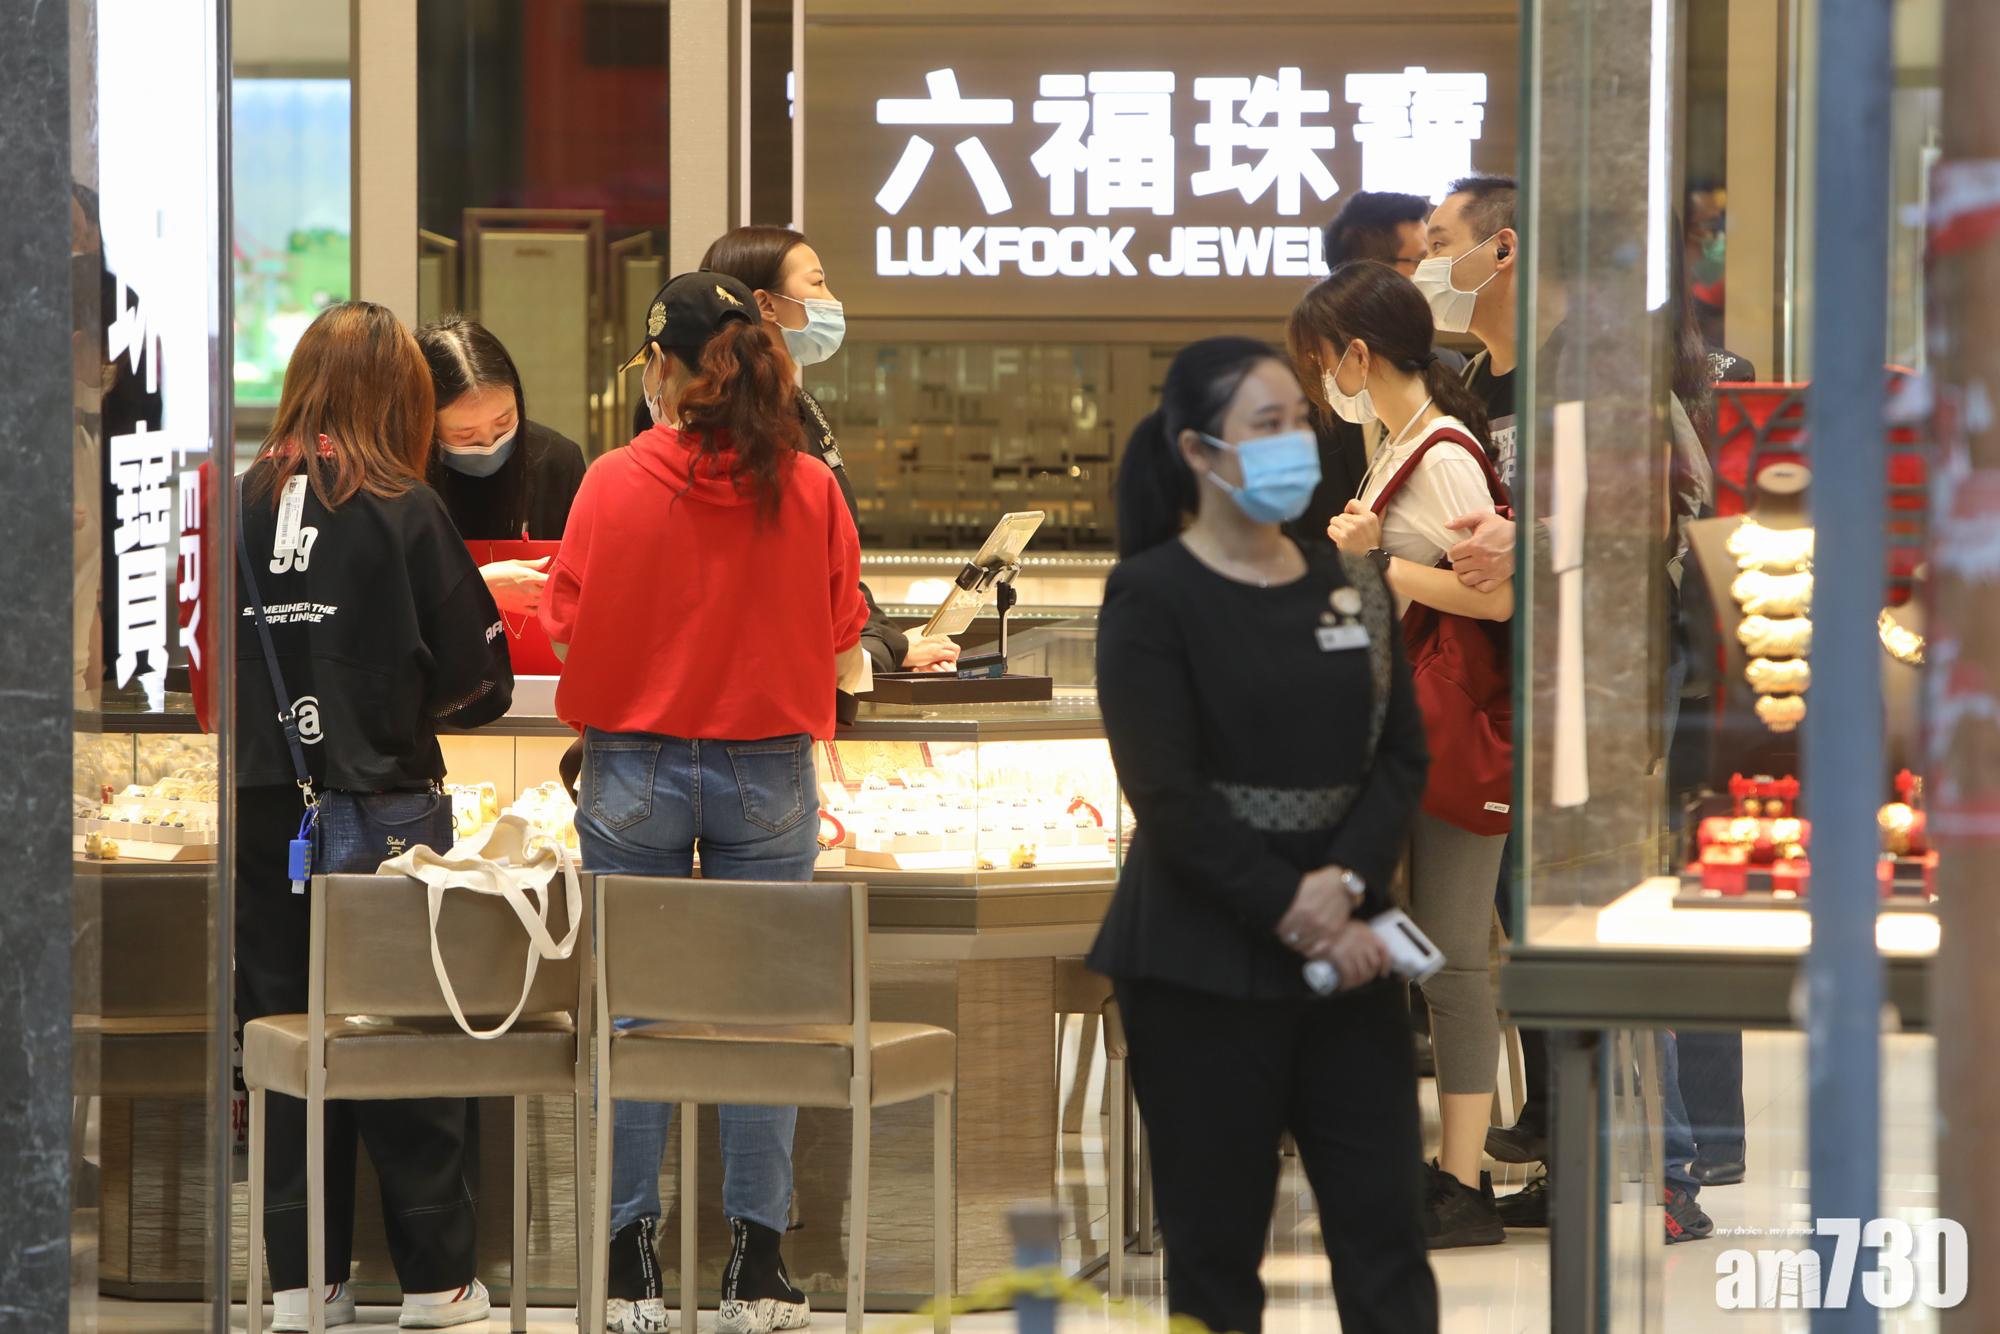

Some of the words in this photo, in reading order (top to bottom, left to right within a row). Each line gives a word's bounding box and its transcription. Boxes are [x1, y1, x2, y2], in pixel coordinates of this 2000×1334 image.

[875, 66, 1487, 216] 六福珠寶
[876, 226, 1137, 276] LUKFOOK
[1149, 226, 1331, 276] JEWEL
[178, 450, 202, 671] ERY
[311, 603, 338, 615] THE
